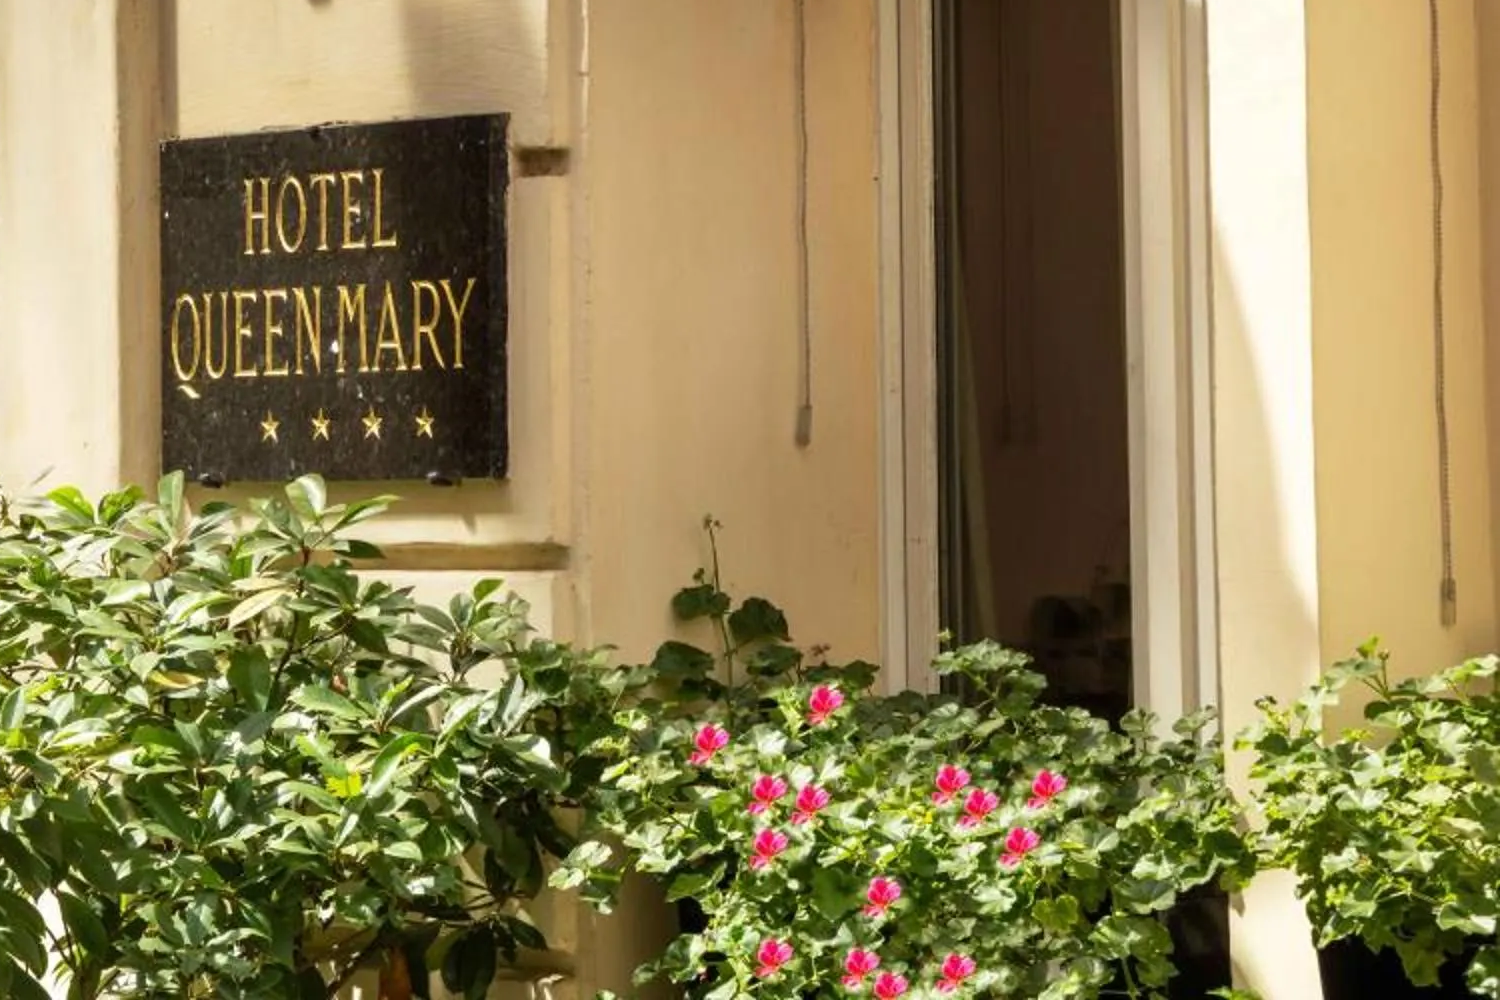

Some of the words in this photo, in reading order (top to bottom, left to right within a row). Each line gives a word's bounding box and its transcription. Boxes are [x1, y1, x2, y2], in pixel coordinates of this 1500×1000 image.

[243, 168, 397, 255] HOTEL
[171, 284, 321, 399] QUEEN
[336, 277, 477, 373] MARY
